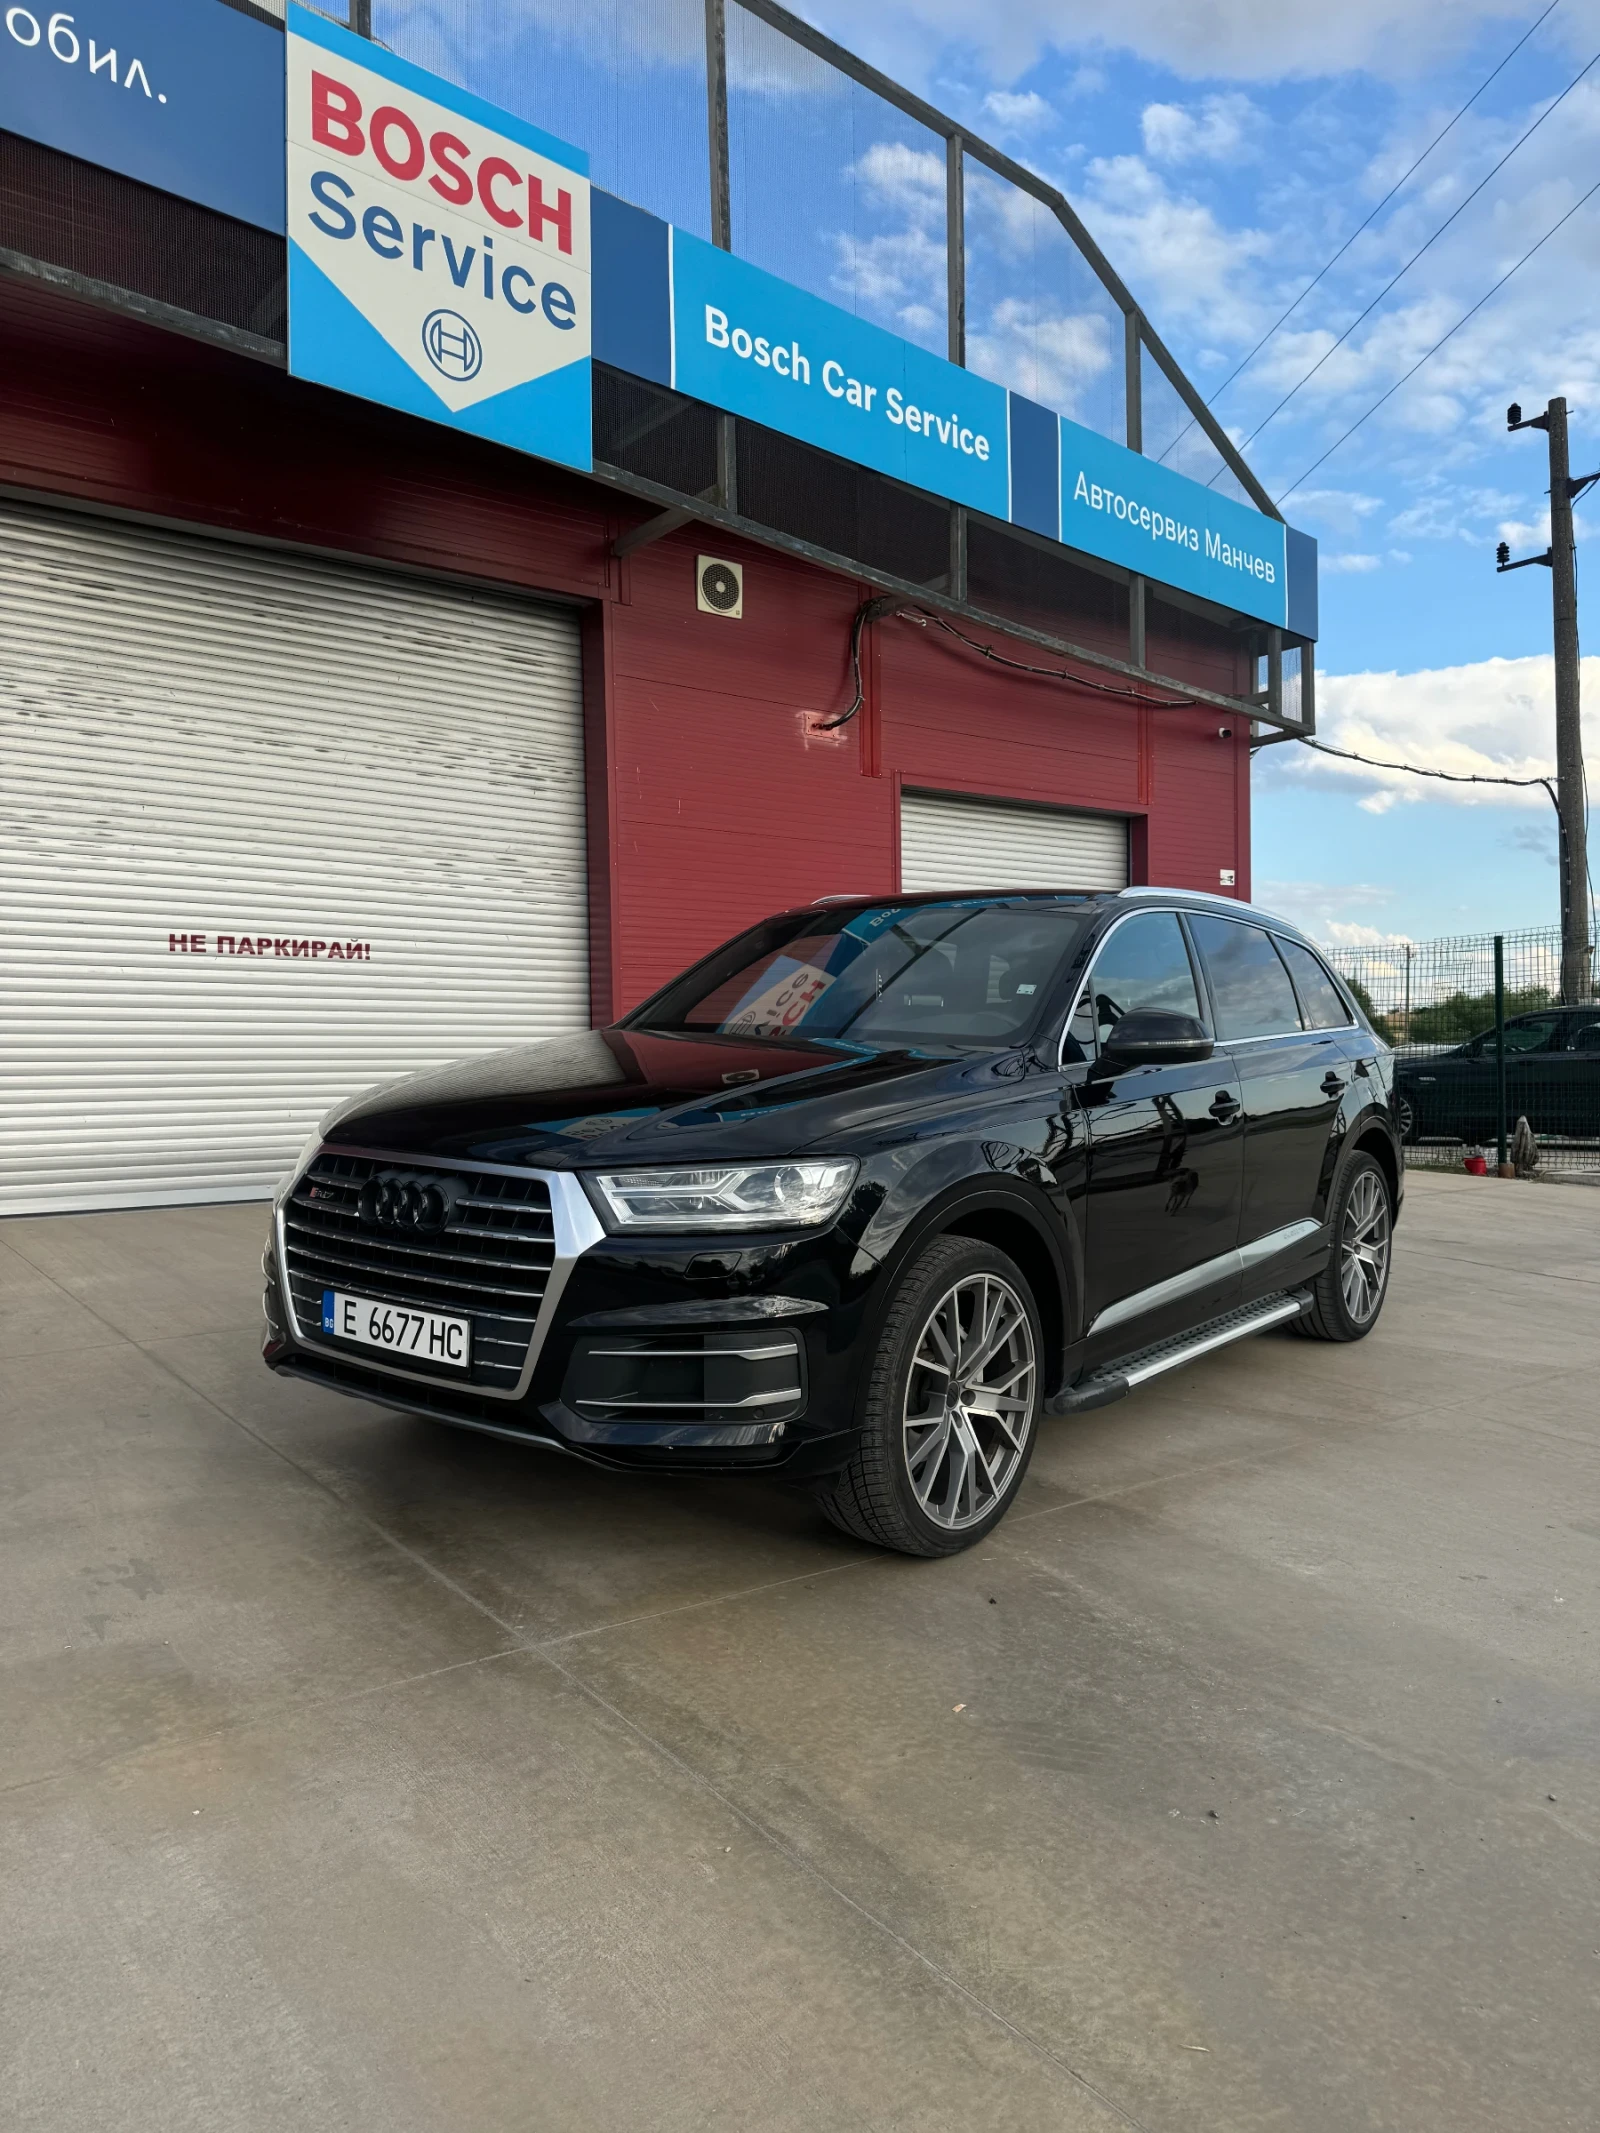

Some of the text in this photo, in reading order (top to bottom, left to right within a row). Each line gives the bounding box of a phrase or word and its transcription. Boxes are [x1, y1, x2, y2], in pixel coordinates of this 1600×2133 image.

[5, 7, 168, 104] обил.
[310, 69, 573, 256] BOSCH
[308, 170, 577, 331] Service
[704, 304, 990, 462] Bosch Car Service
[1073, 471, 1276, 584] Автосервиз Манчев
[168, 933, 372, 961] НЕ ПАРКИРАЙ!
[324, 1316, 335, 1329] BG
[344, 1299, 463, 1360] E 6677 HC
